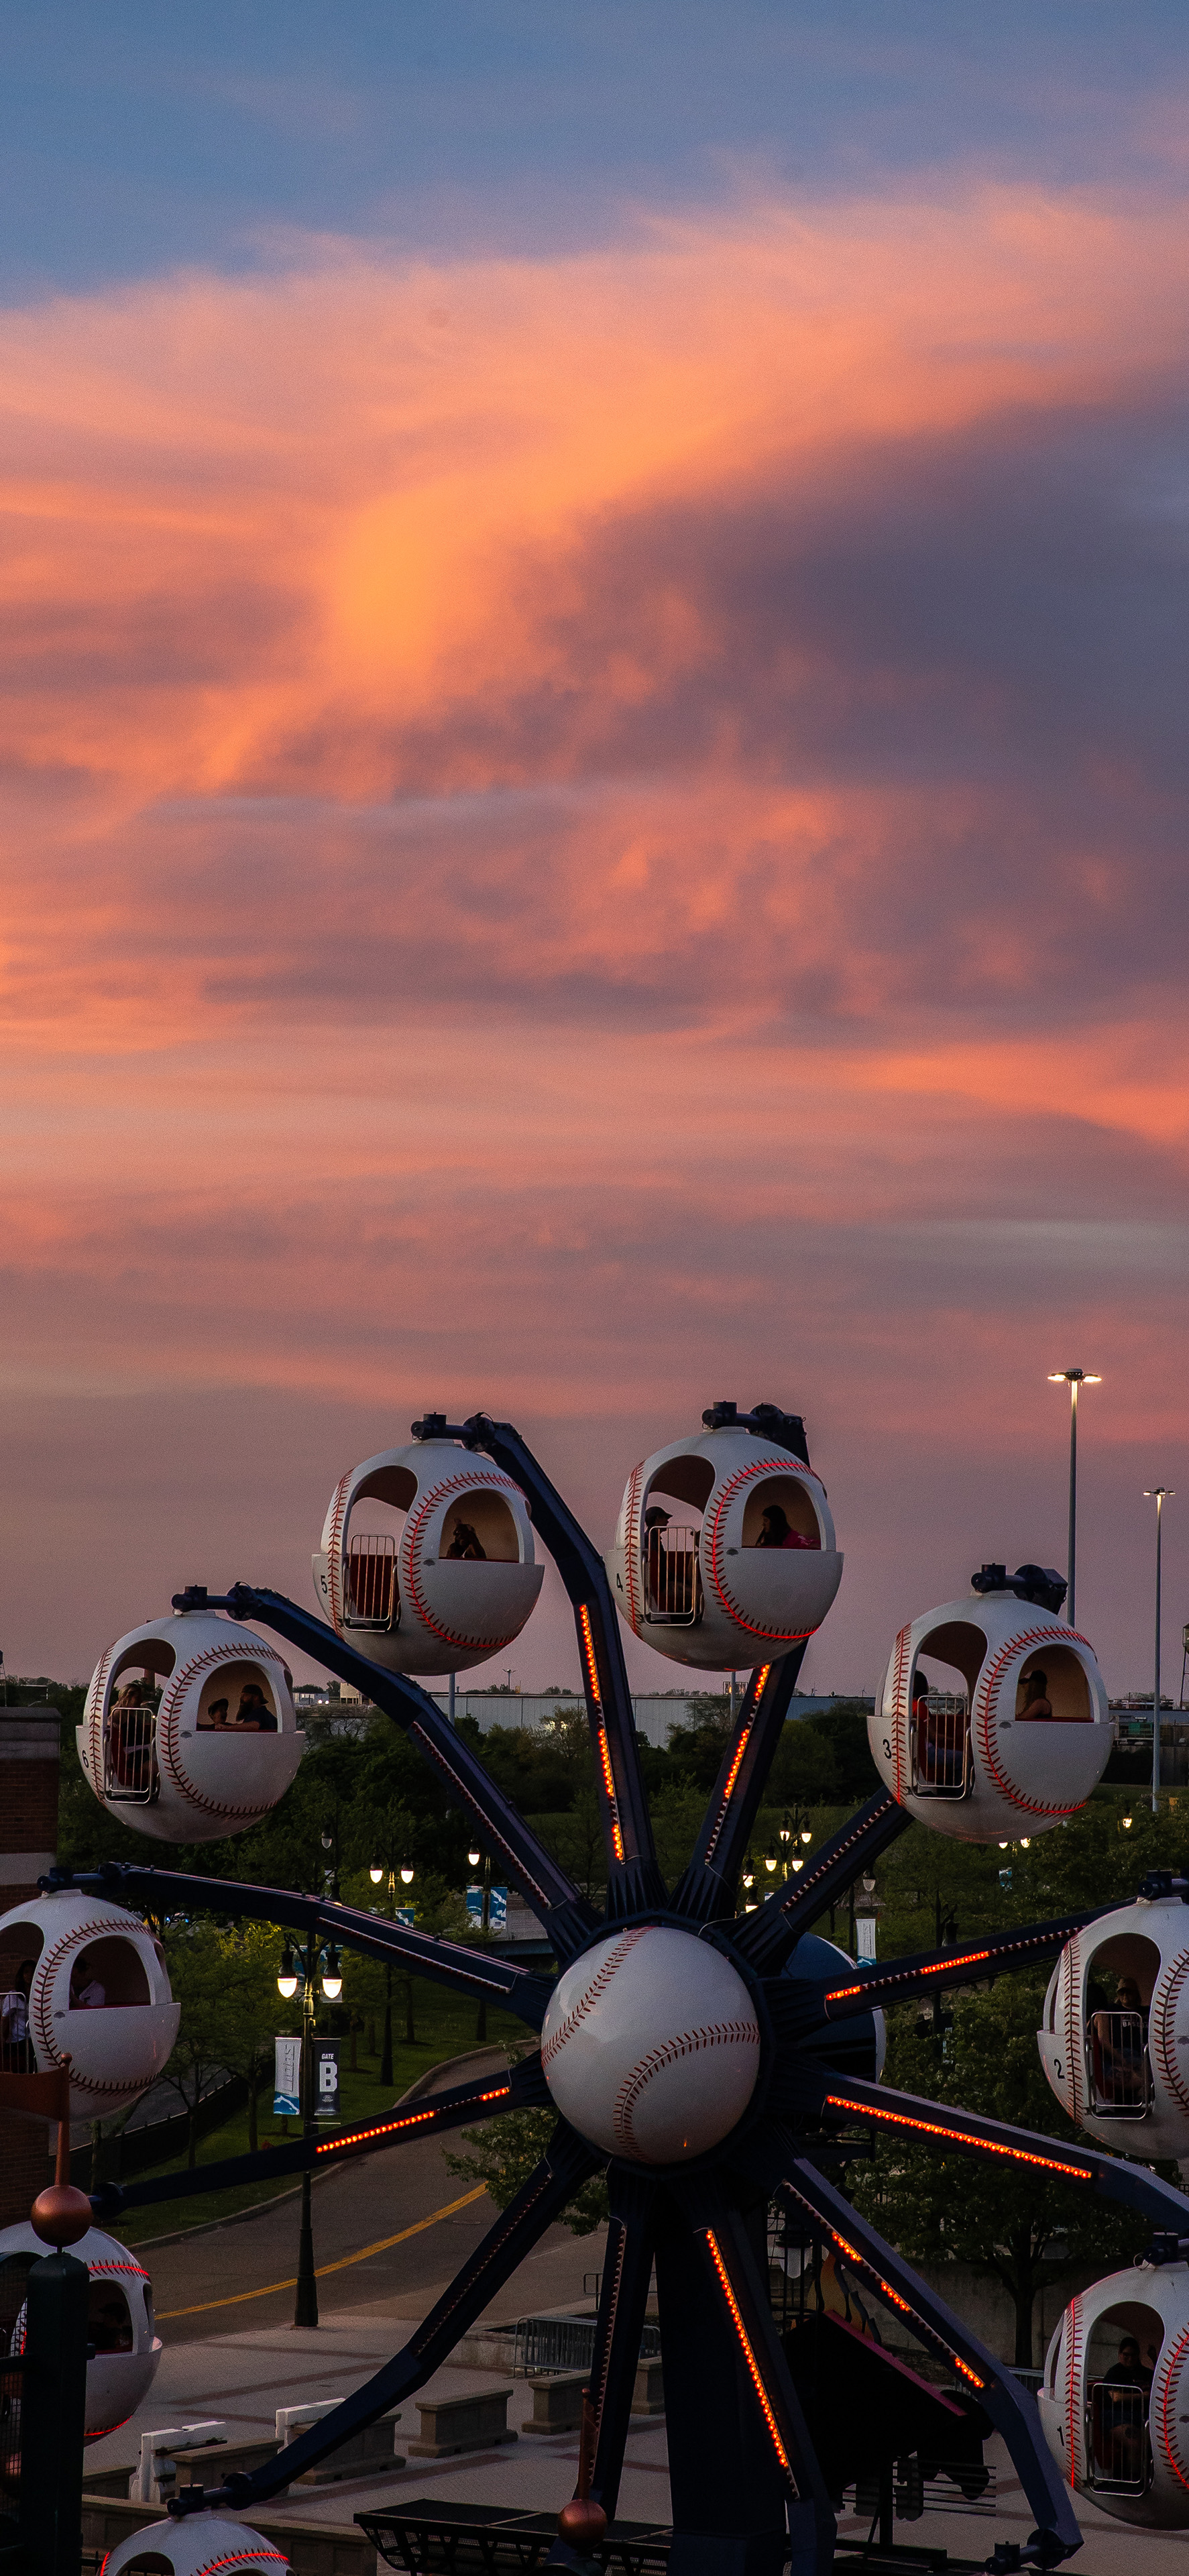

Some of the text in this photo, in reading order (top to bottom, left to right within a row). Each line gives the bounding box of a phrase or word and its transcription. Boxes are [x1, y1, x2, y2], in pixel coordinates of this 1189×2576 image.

[321, 1575, 327, 1594] 5
[616, 1573, 623, 1592] 4
[82, 1750, 89, 1768] 6
[883, 1739, 891, 1759] 3
[319, 2061, 337, 2092] B
[1054, 2058, 1065, 2079] 2
[1056, 2426, 1064, 2447] 1
